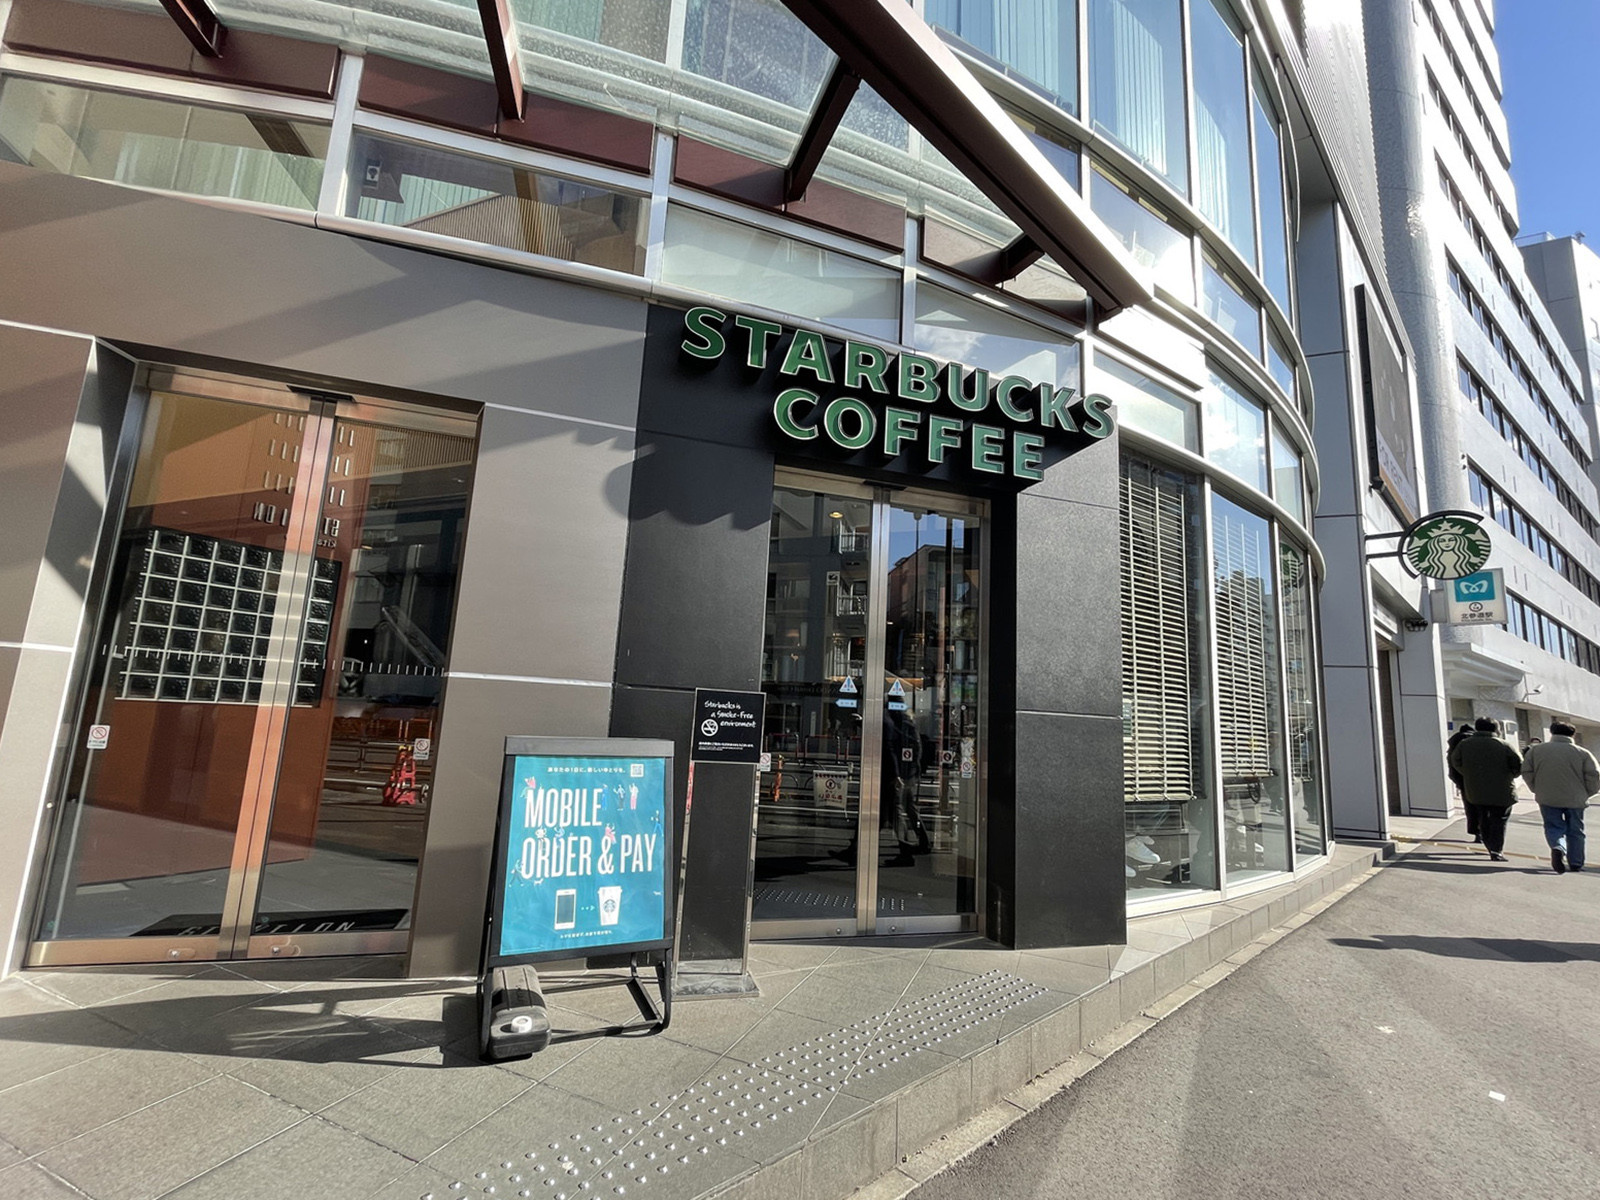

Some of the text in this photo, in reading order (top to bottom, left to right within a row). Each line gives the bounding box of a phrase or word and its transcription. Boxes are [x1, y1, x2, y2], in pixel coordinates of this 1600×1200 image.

[681, 306, 1114, 439] STARBUCKS
[773, 388, 1046, 481] COFFEE
[720, 720, 757, 728] environment
[524, 788, 603, 828] MOBILE
[521, 833, 657, 880] ORDER & PAY
